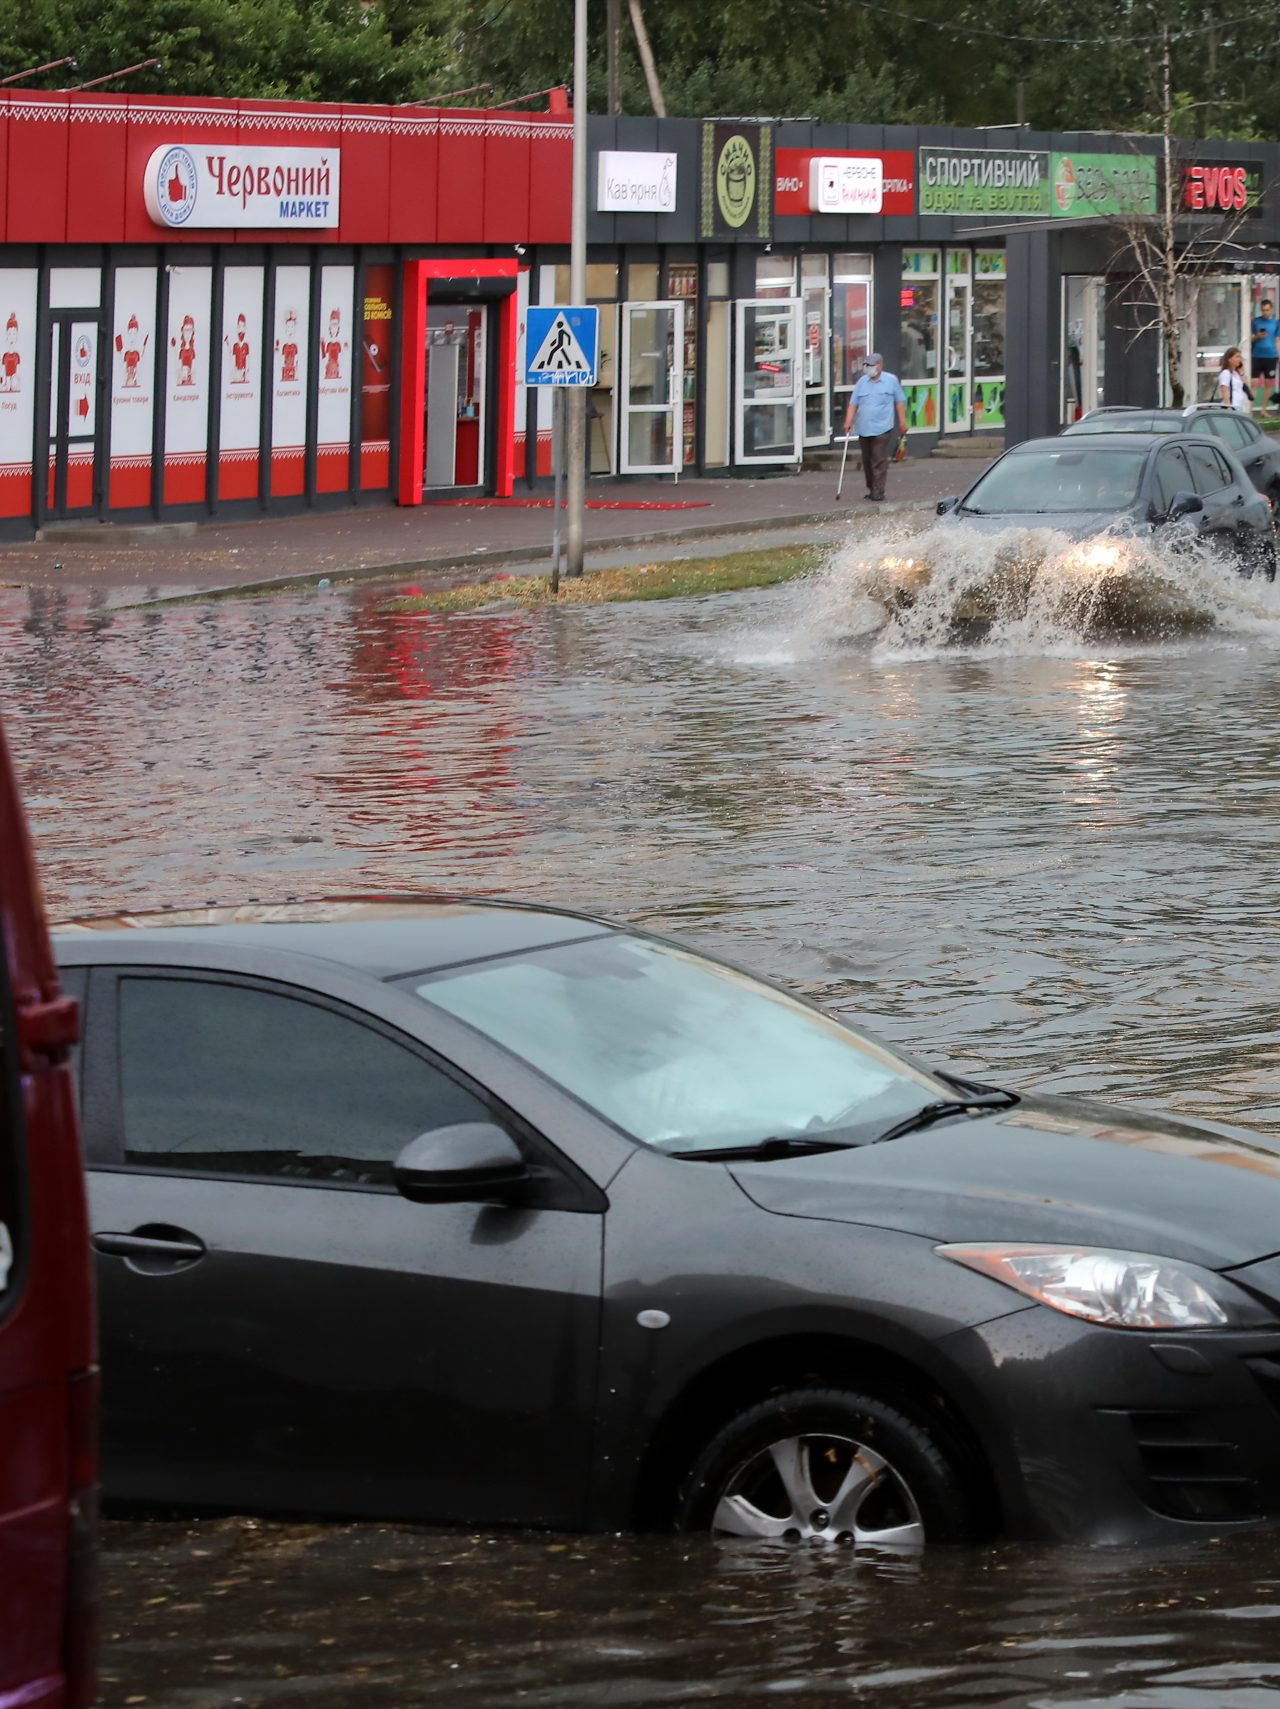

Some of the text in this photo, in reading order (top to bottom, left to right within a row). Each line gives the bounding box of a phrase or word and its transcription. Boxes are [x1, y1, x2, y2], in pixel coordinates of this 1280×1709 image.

[925, 154, 1040, 189] СПОРТИВНИЙ
[206, 155, 330, 210] Червоний
[776, 177, 799, 192] ВИНО
[1186, 166, 1247, 210] EVOS
[279, 201, 329, 218] МАРКЕТ
[925, 192, 964, 212] ОДЯГ
[988, 193, 1043, 211] ВЗУТТЯ
[74, 373, 91, 386] ВХІД
